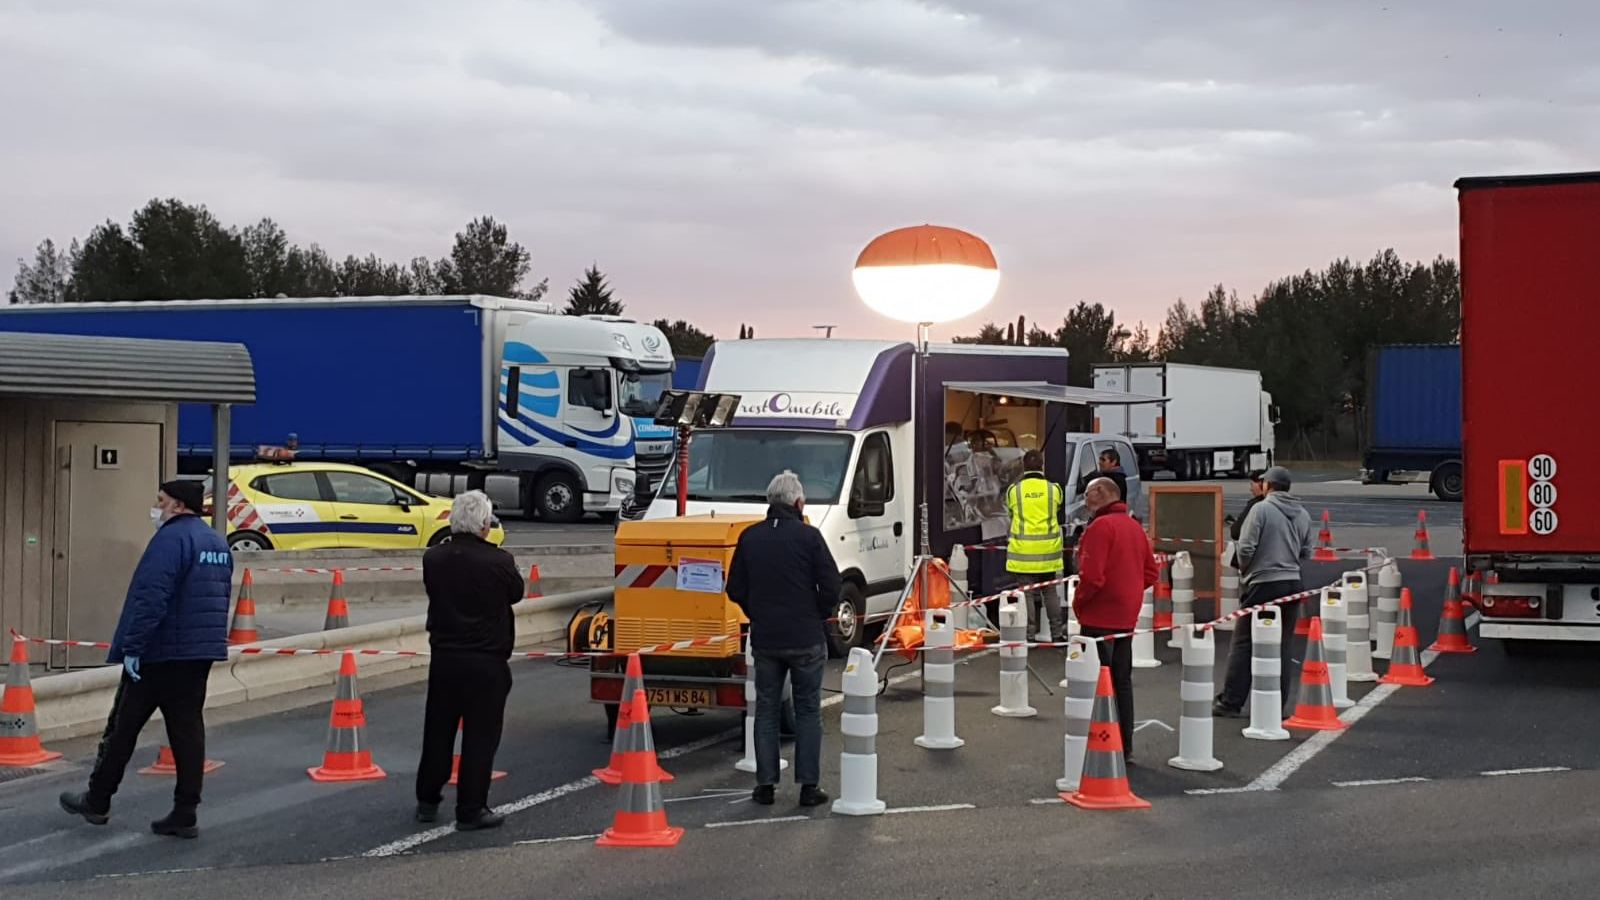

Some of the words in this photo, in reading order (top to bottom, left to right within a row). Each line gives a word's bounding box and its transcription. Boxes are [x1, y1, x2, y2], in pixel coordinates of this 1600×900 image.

[1533, 457, 1551, 478] 90
[1533, 484, 1552, 505] 80
[1534, 511, 1552, 531] 60
[673, 690, 689, 703] WS
[691, 691, 705, 704] 84
